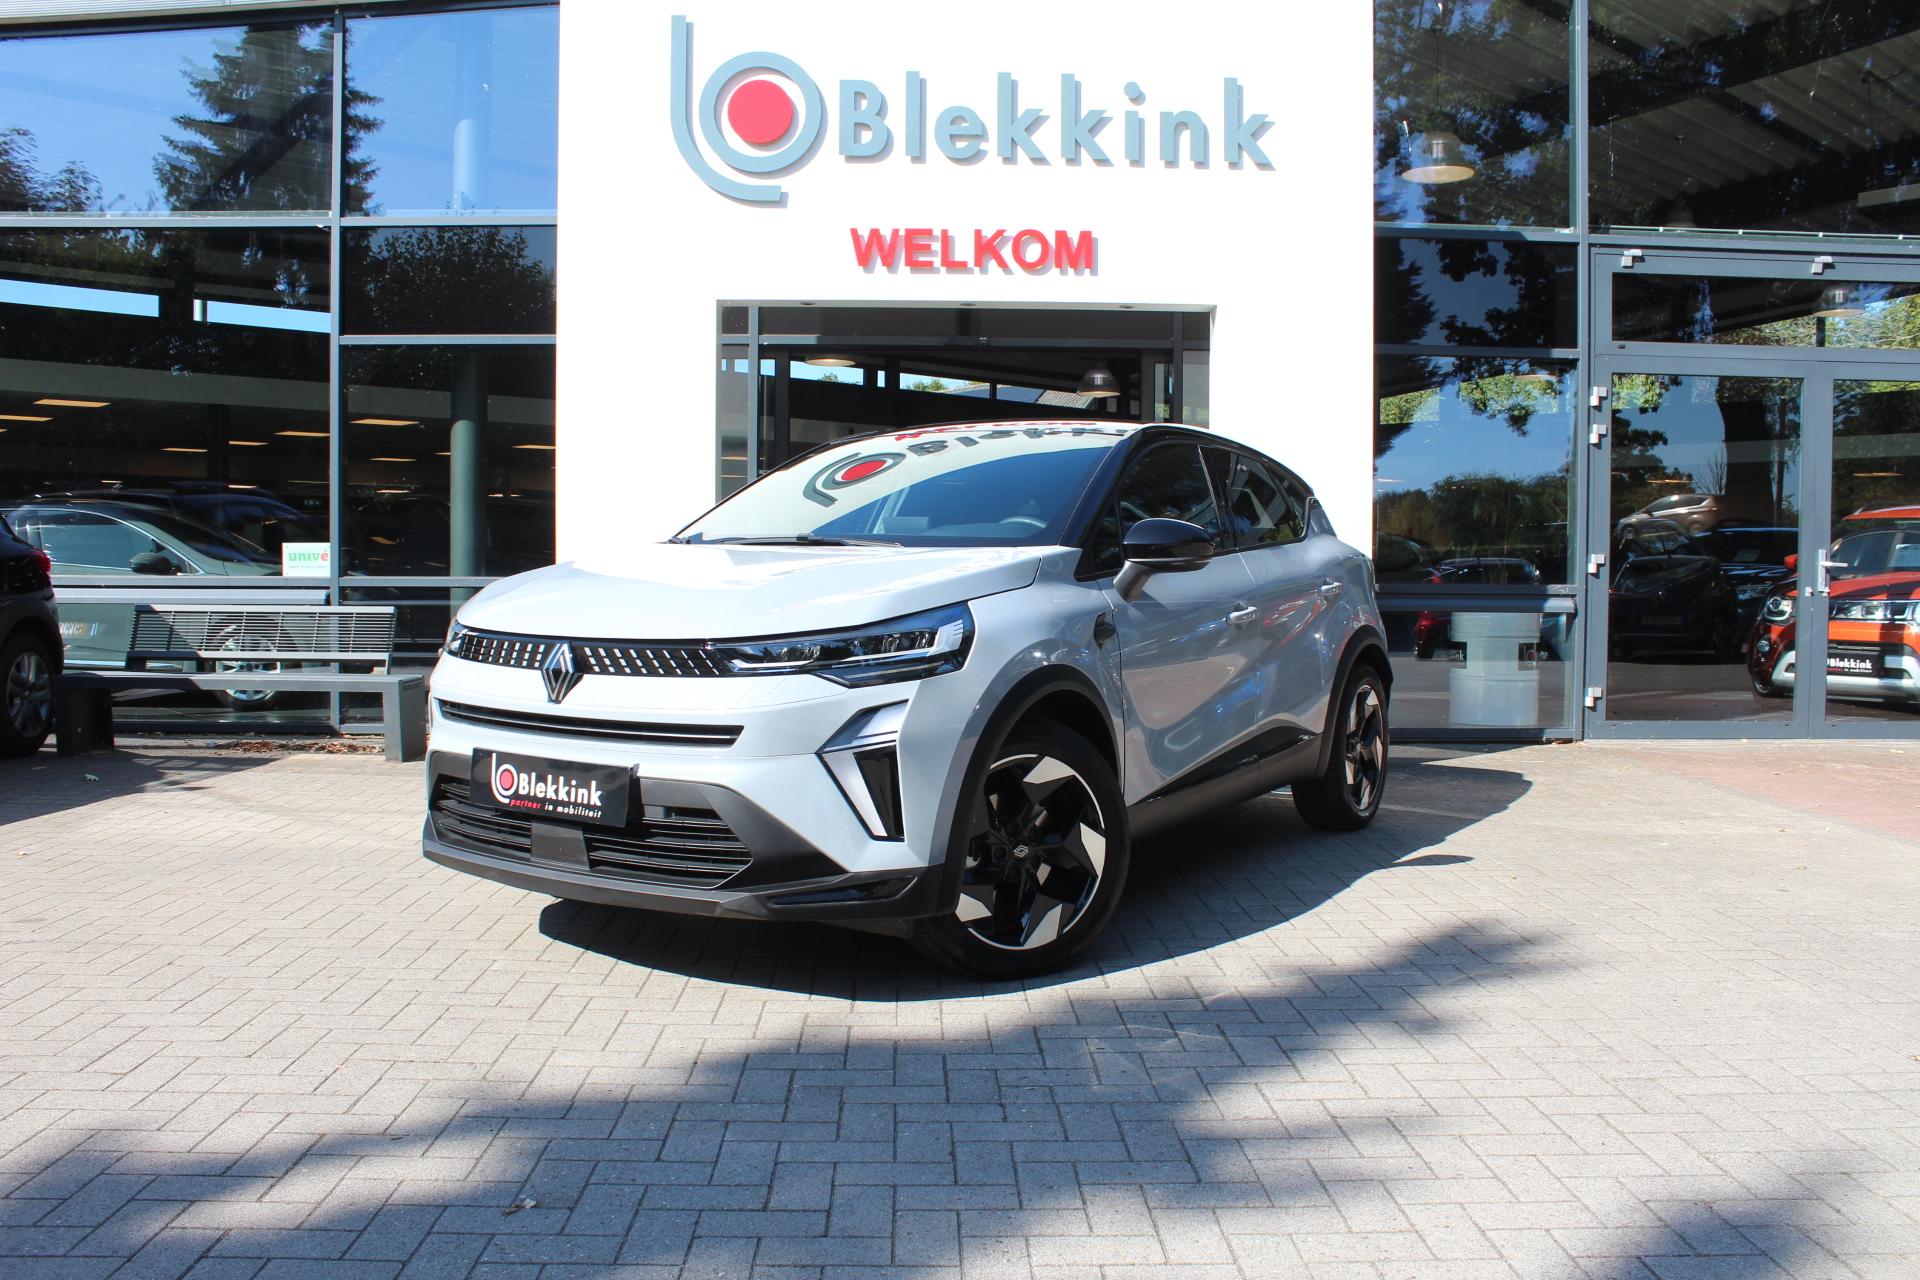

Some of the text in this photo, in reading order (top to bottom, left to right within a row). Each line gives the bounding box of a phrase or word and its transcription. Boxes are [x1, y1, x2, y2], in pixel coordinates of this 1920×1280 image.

[838, 70, 1274, 167] Blekkink
[850, 227, 1094, 271] WELKOM
[509, 799, 602, 818] partner in mobiliteit
[518, 772, 602, 806] Blekkink
